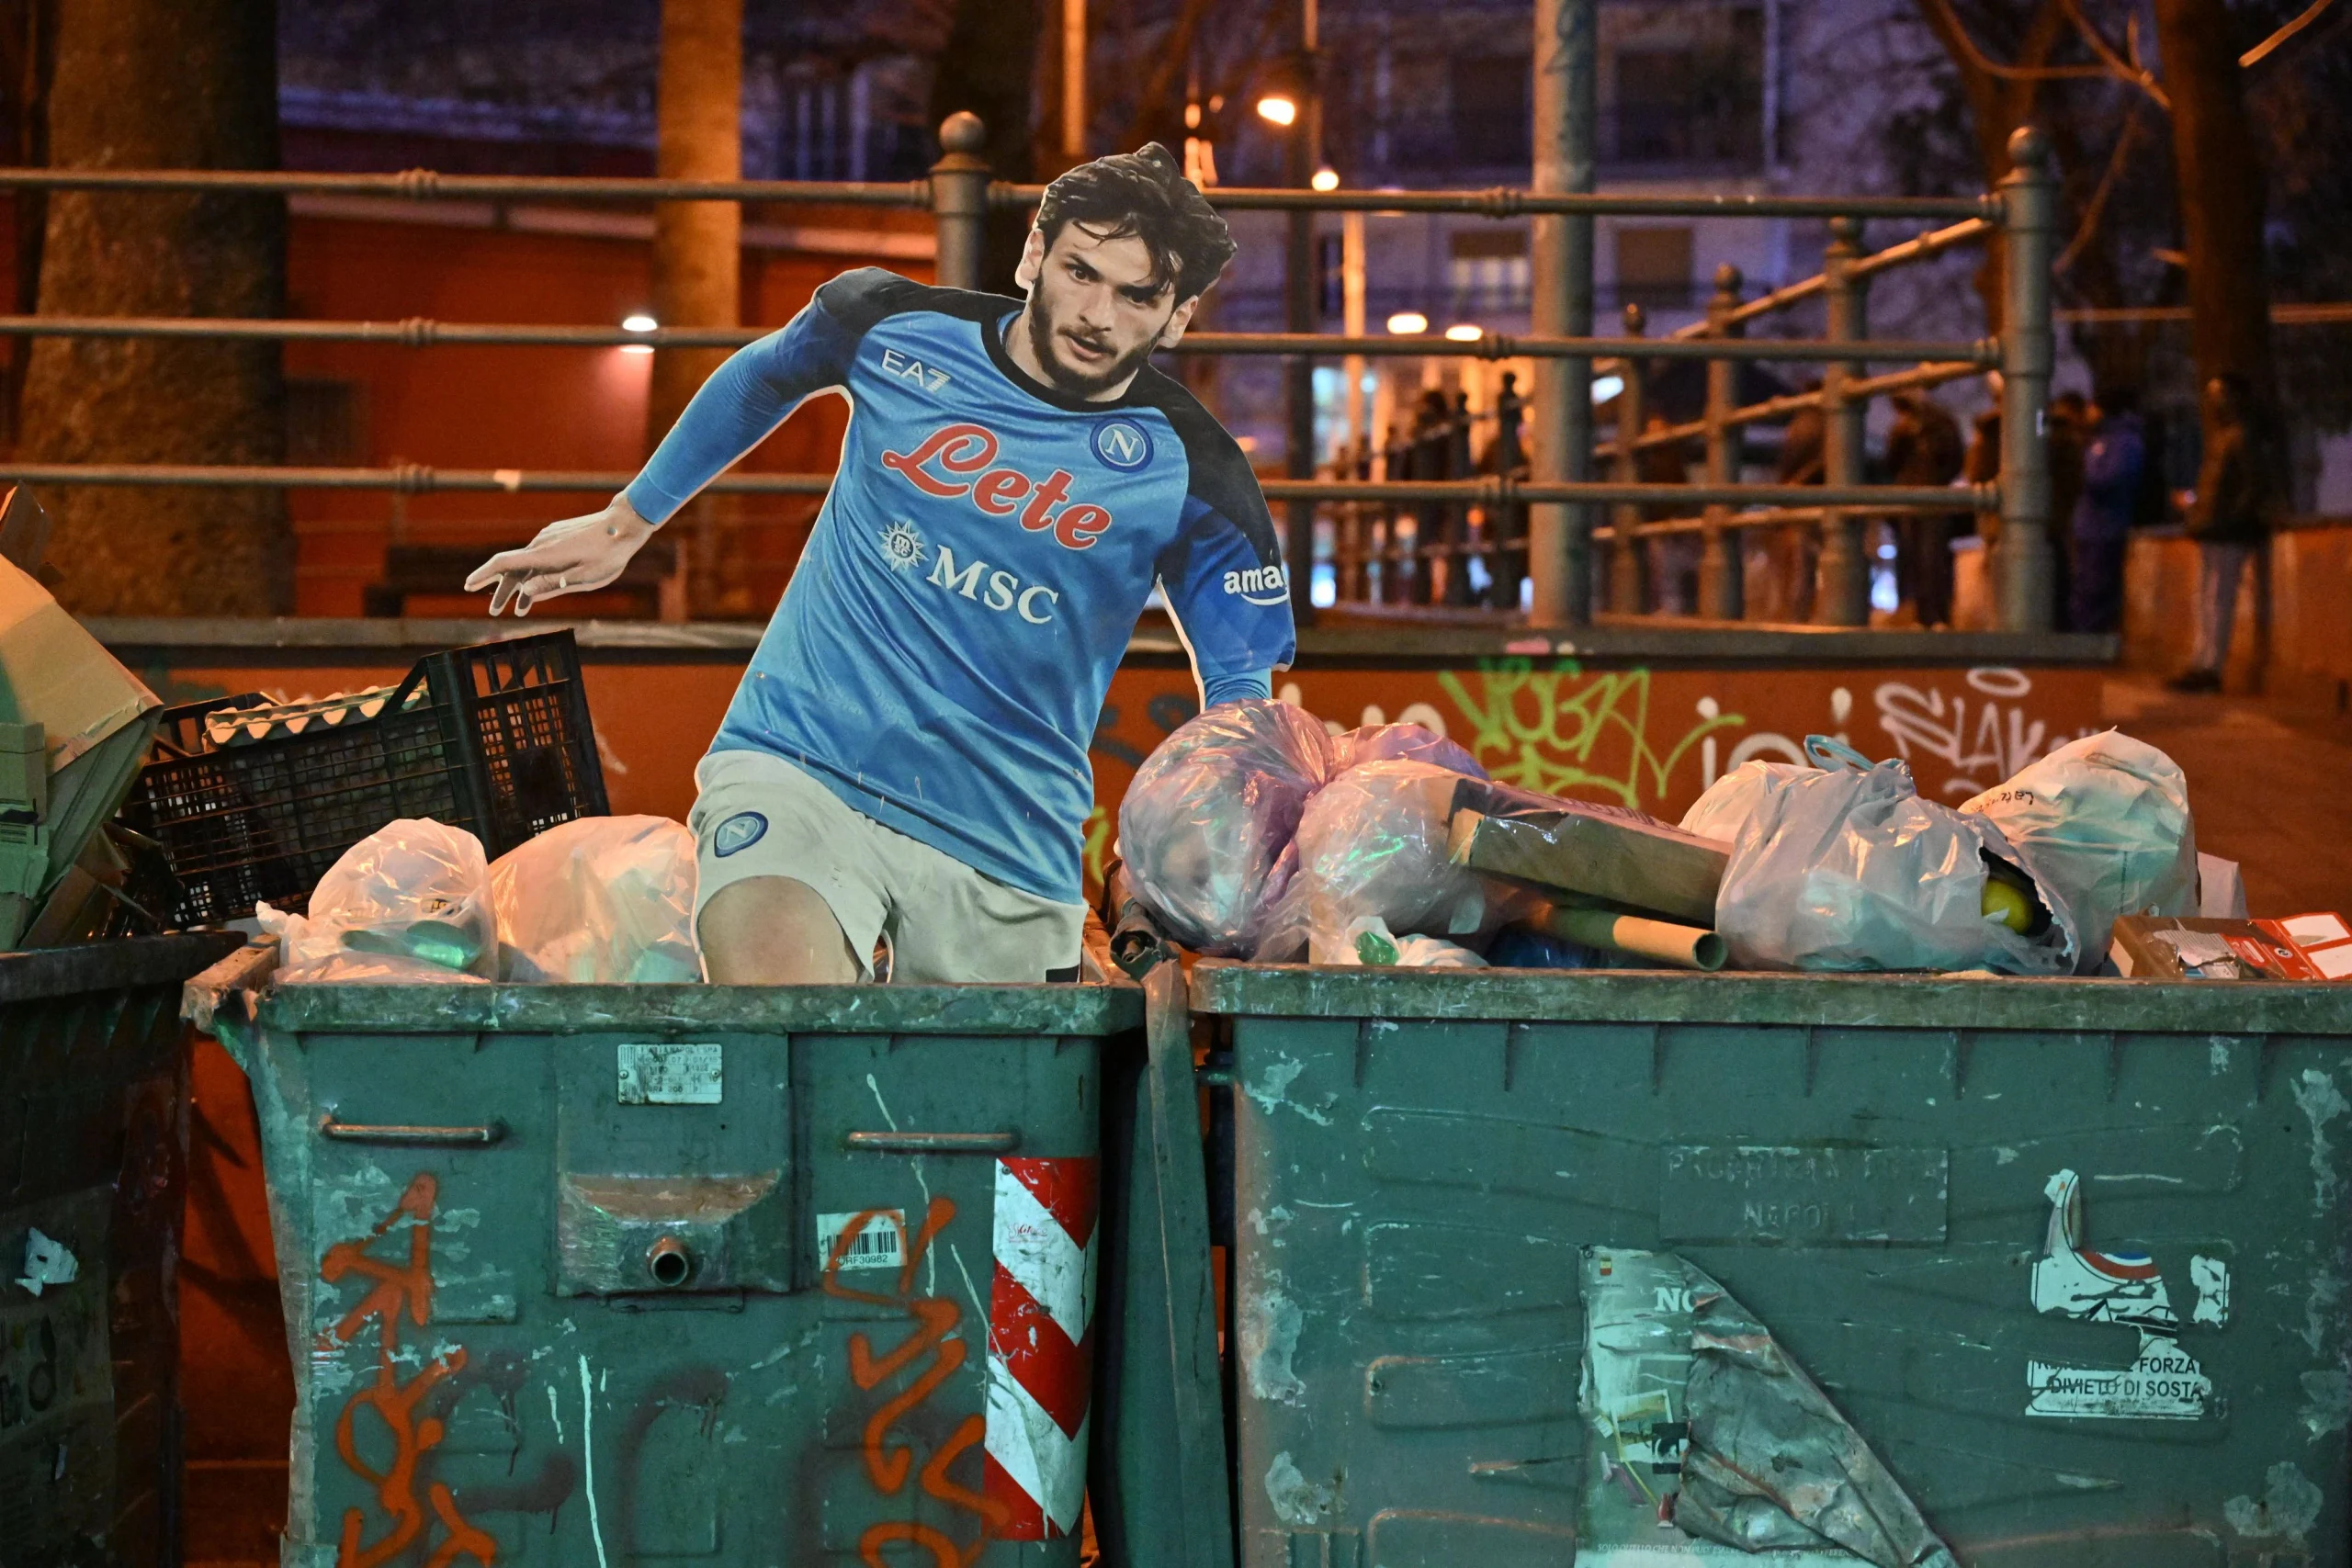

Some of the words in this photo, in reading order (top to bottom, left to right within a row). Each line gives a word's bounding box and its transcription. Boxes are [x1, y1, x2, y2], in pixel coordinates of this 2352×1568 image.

[882, 348, 951, 394] EA7
[1105, 431, 1141, 461] N
[882, 423, 1112, 550] Lete
[926, 545, 1059, 626] MSC
[1223, 565, 1286, 595] ama
[2139, 1357, 2197, 1374] FORZA
[2051, 1378, 2118, 1395] DIVIETO
[2124, 1380, 2140, 1395] DI
[2145, 1380, 2203, 1398] SOSTA
